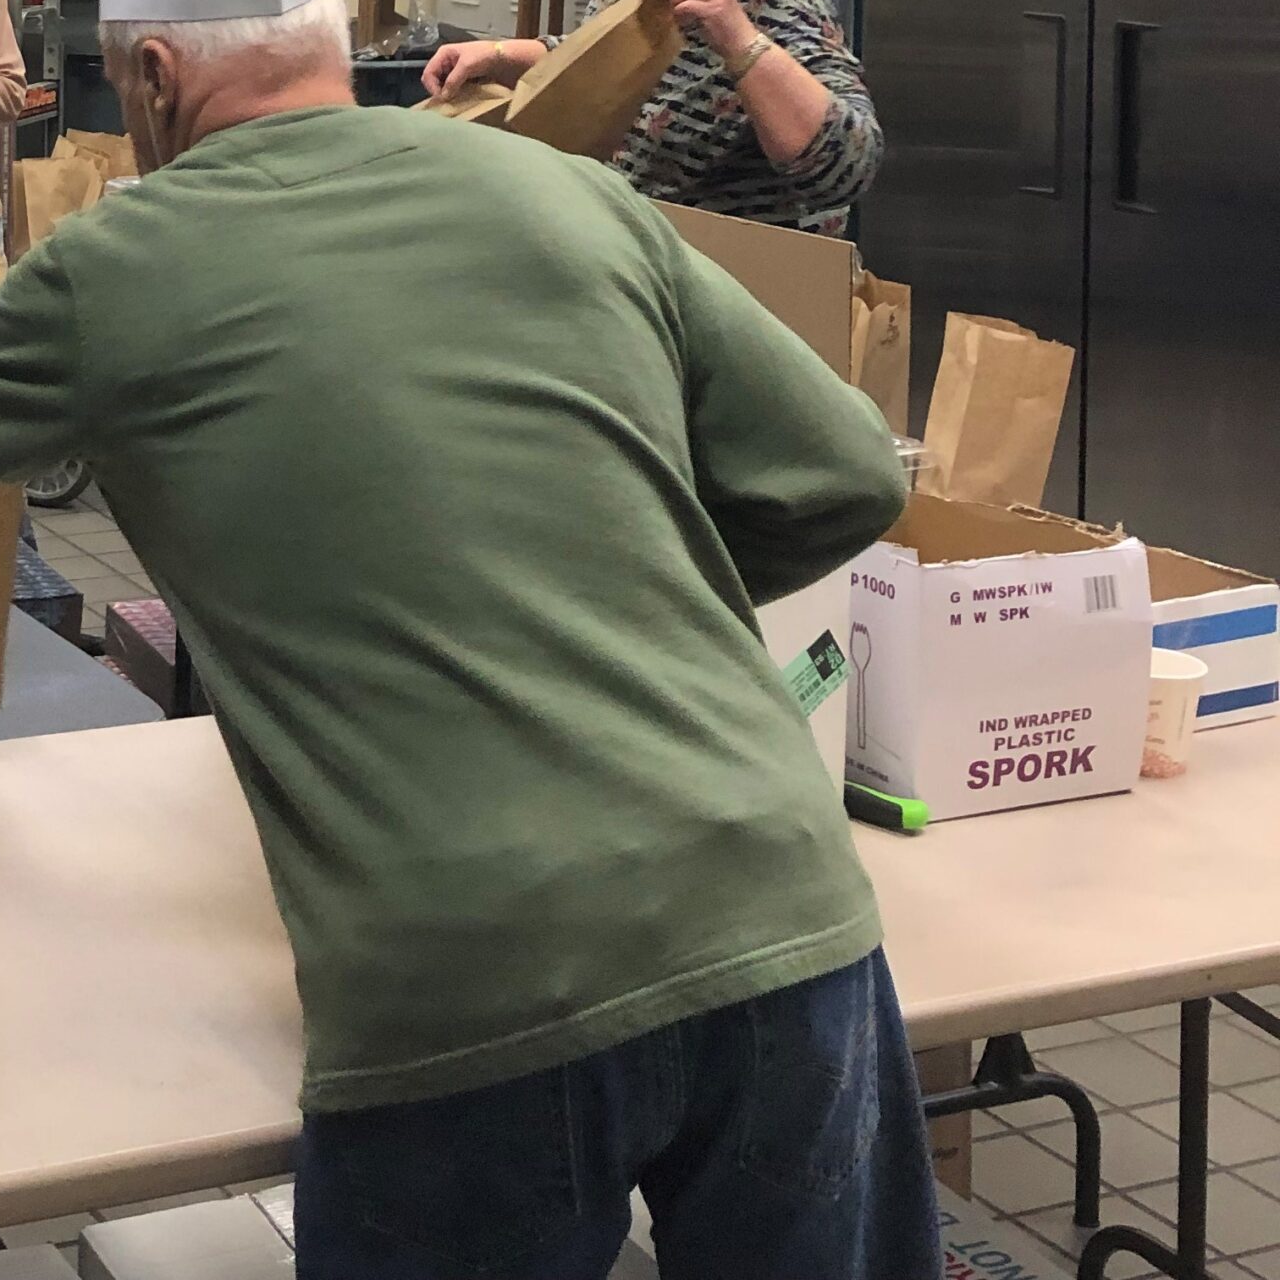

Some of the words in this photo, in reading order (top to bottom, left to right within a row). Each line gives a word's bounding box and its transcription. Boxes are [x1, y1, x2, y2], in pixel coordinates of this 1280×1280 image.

[861, 574, 896, 600] 1000
[950, 591, 961, 604] G
[950, 614, 962, 626] M
[974, 611, 987, 624] W
[999, 607, 1030, 622] SPK
[979, 718, 1009, 733] IND
[1014, 708, 1092, 729] WRAPPED
[994, 728, 1075, 751] PLASTIC
[967, 745, 1096, 790] SPORK
